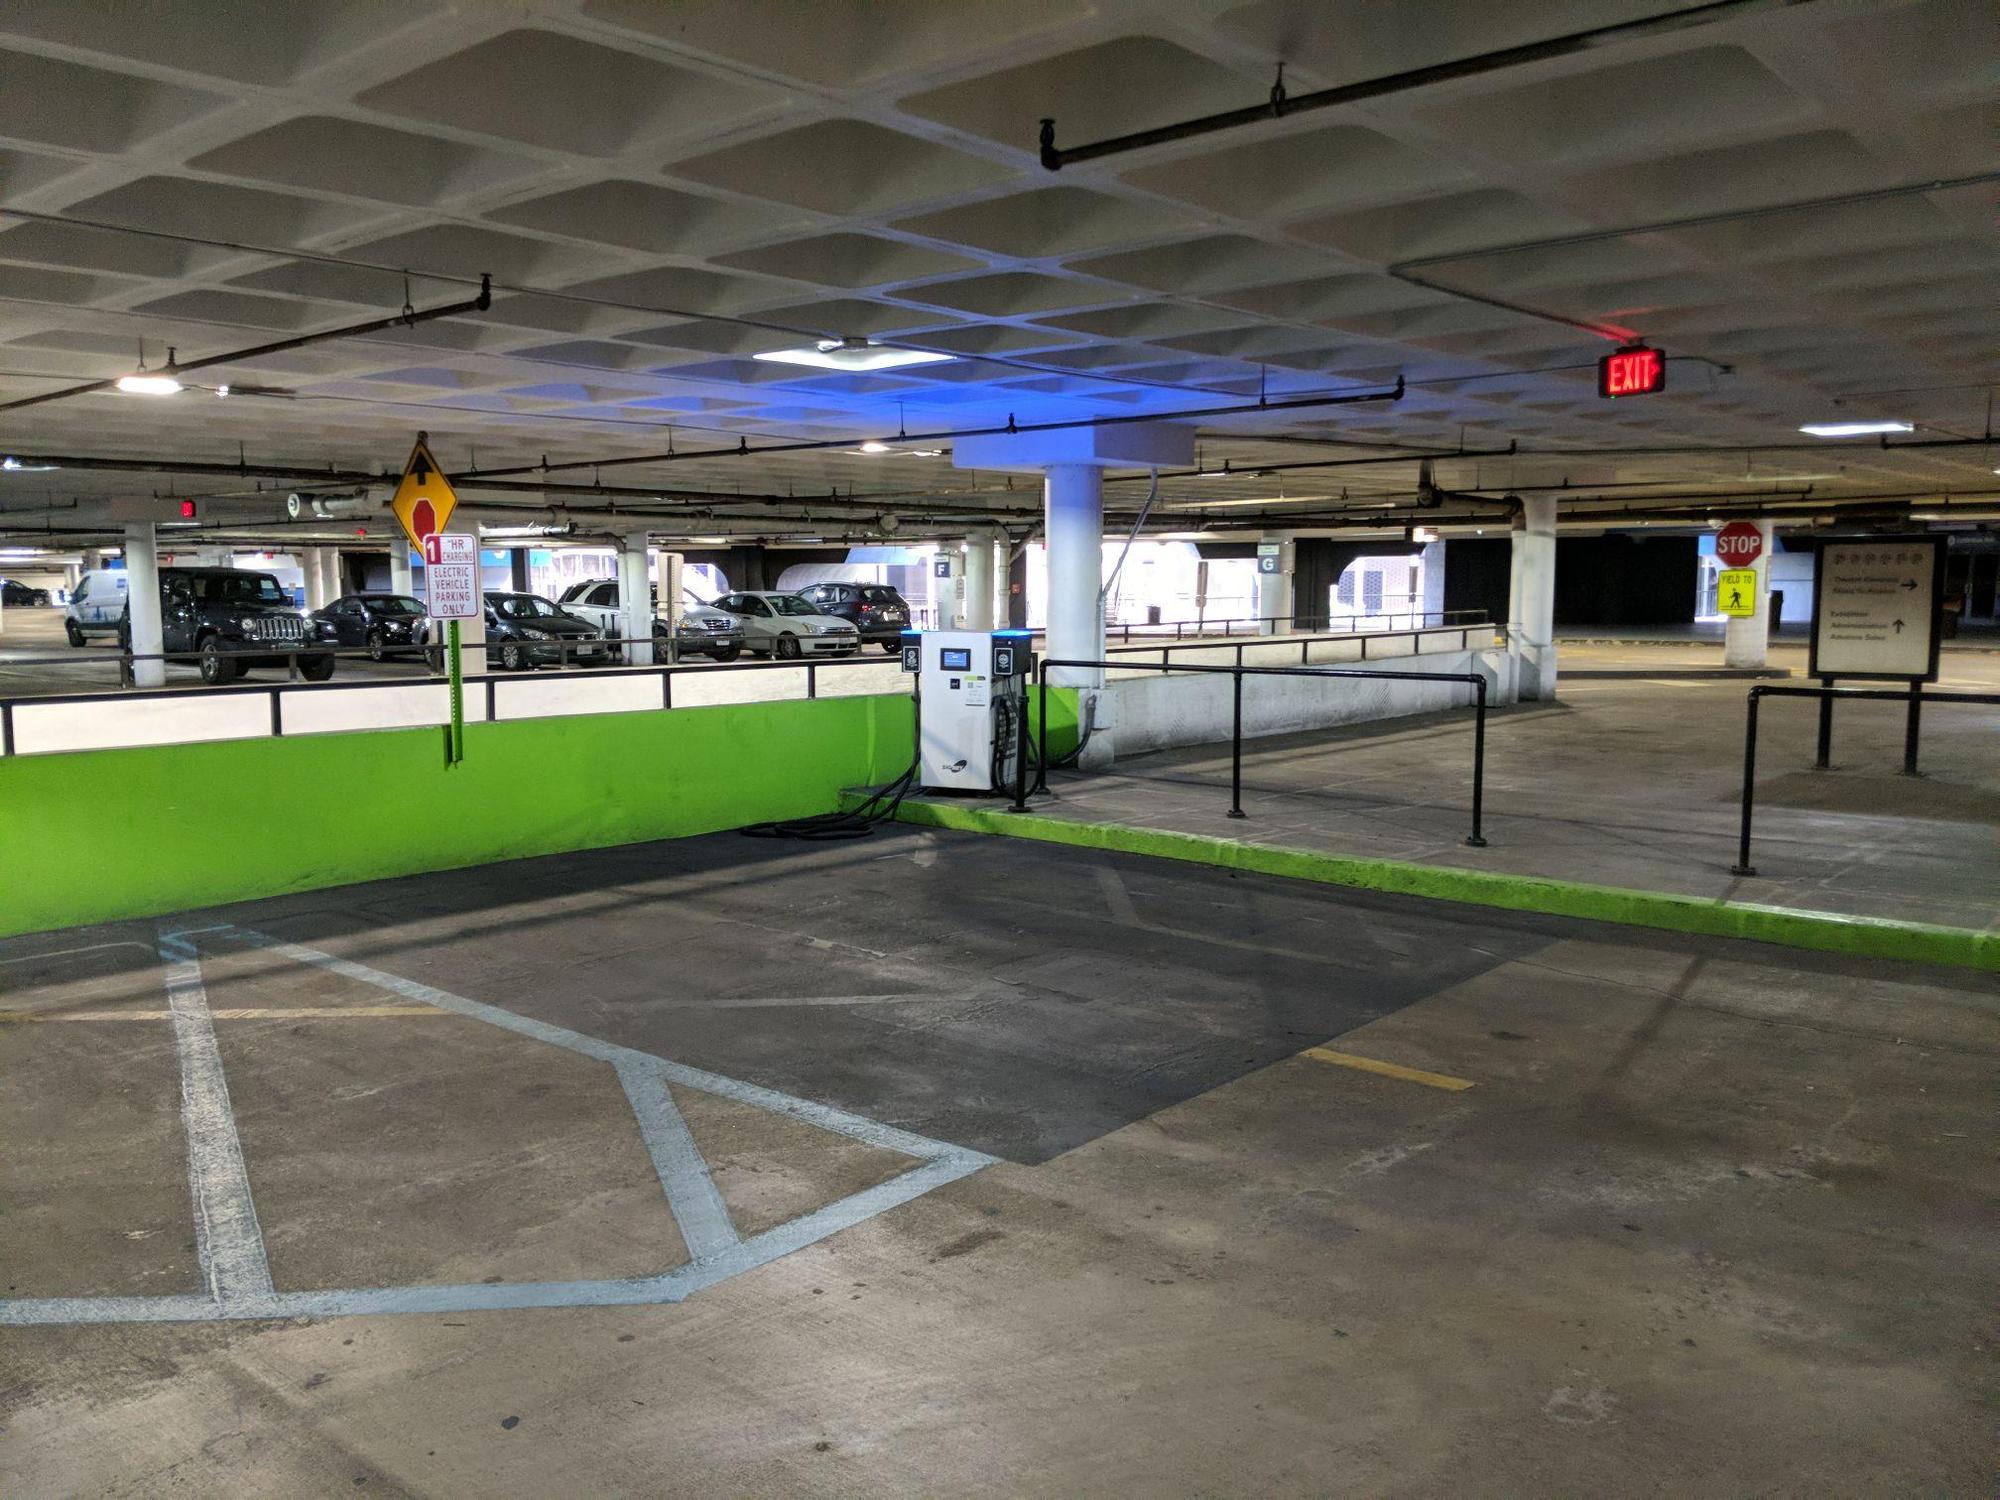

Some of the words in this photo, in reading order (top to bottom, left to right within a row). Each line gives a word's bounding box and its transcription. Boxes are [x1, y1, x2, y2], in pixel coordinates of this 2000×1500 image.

[1609, 355, 1652, 392] EXIT
[426, 541, 436, 562] 1
[451, 539, 465, 550] HR
[1718, 536, 1760, 554] STOP
[937, 564, 946, 576] F
[1262, 558, 1274, 571] G
[434, 567, 469, 578] ELECTRIC
[435, 579, 470, 590] VEHICLE
[1721, 574, 1741, 585] YIELD
[1744, 575, 1753, 585] TO
[435, 591, 471, 602] PARKING
[442, 604, 465, 615] ONLY
